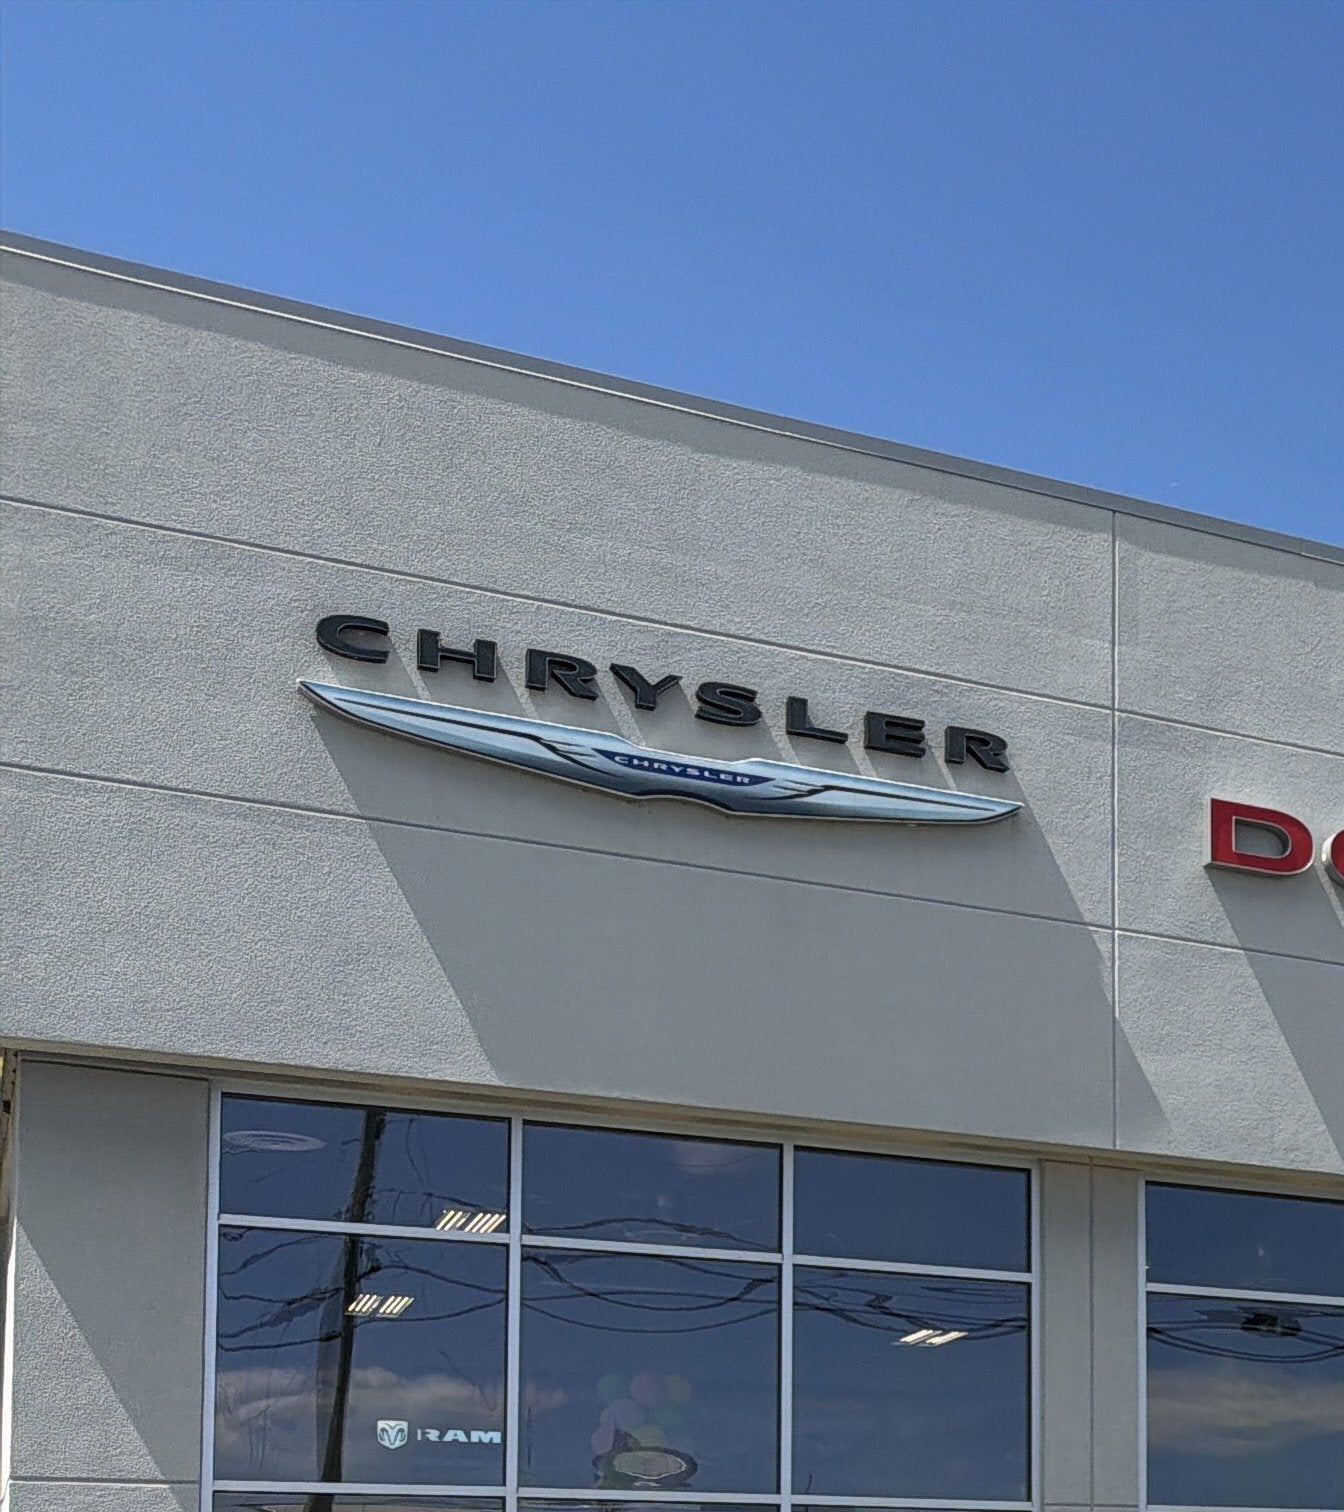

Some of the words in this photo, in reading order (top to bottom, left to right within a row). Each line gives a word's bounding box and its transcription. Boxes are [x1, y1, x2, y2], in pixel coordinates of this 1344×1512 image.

[316, 613, 1010, 772] CHRYSLER
[613, 755, 751, 785] CHRYSLER
[416, 1428, 502, 1444] RAM
